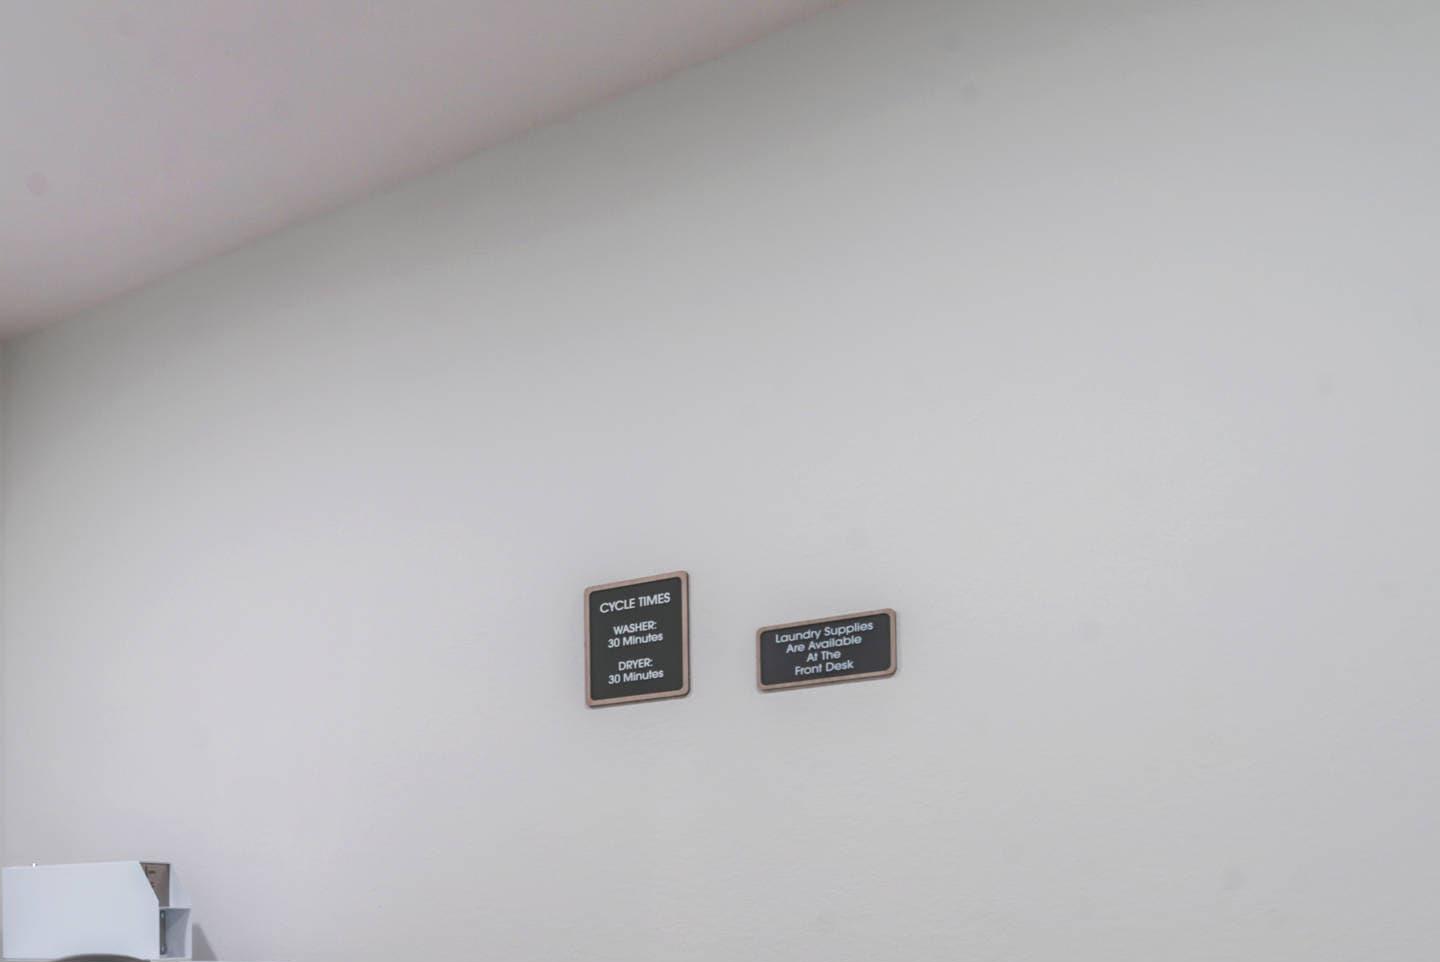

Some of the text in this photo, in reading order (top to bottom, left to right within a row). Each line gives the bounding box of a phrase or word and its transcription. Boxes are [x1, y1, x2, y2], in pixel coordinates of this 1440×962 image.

[600, 592, 671, 613] CYCLE TIMES
[613, 620, 657, 635] WASHER:
[775, 622, 874, 643] Laundry Supplies
[608, 633, 664, 648] 30 Minutes
[786, 635, 862, 654] Are Available
[618, 657, 653, 671] DRYER:
[806, 651, 841, 662] At The
[795, 660, 854, 676] Front Desk
[608, 670, 664, 684] 30 Minutes
